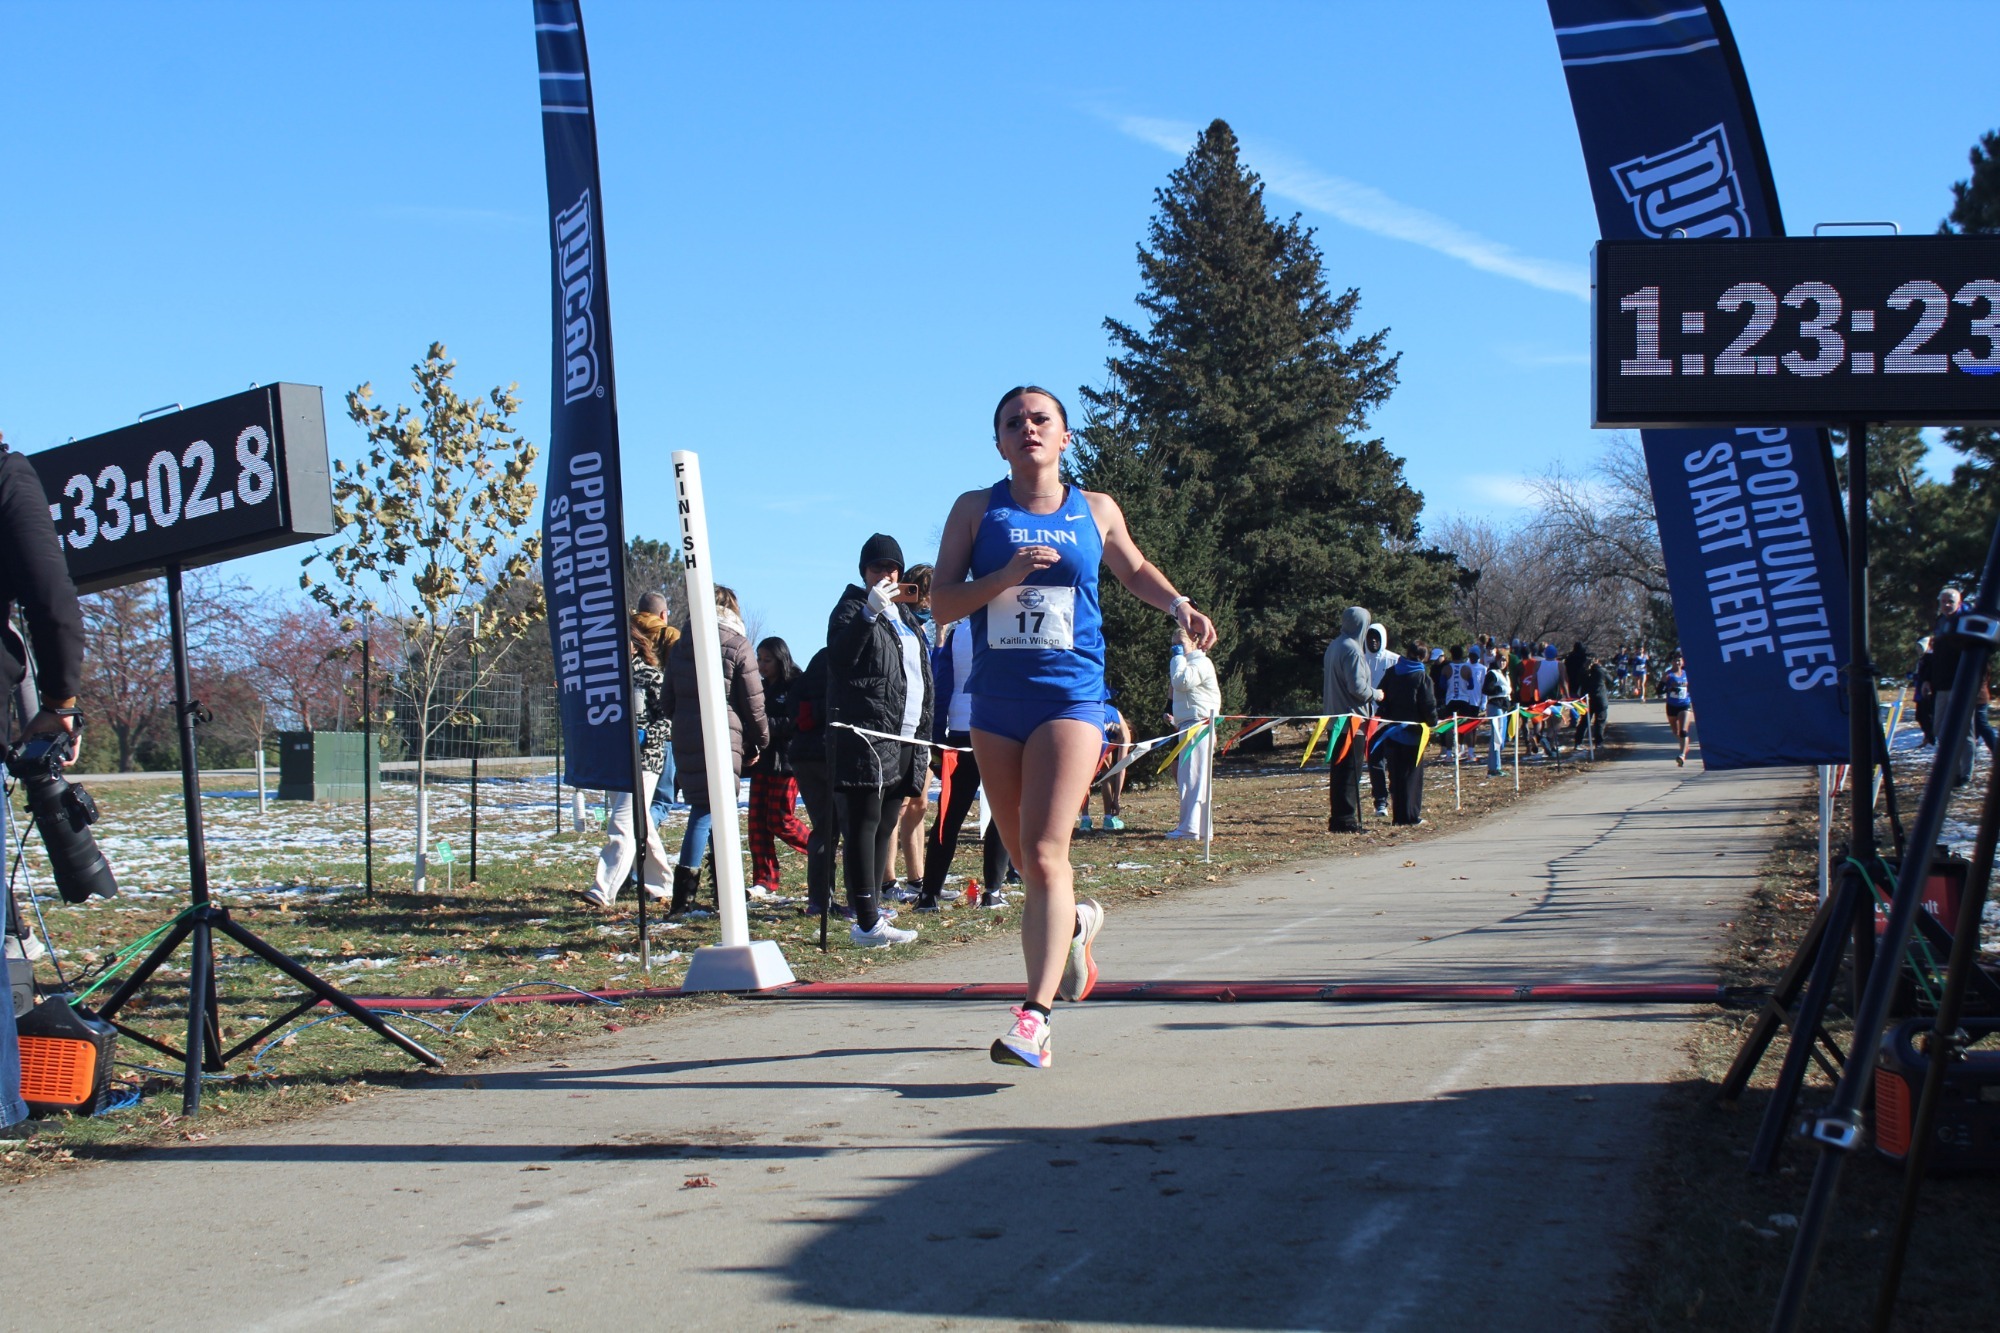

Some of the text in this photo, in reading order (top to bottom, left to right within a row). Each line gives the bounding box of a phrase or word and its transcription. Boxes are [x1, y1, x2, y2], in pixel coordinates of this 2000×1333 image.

[1620, 280, 2000, 377] 1:23:23
[49, 425, 274, 551] :33:02.8
[674, 463, 697, 570] FINISH
[1008, 528, 1078, 545] BLINN
[549, 494, 585, 694] START HERE
[569, 451, 623, 725] OPPORTUNITIES
[1683, 442, 1775, 663] START HERE
[1735, 428, 1838, 691] PPORTUNITIES
[1000, 636, 1060, 646] Kaitlin Wilson
[1015, 611, 1046, 634] 17
